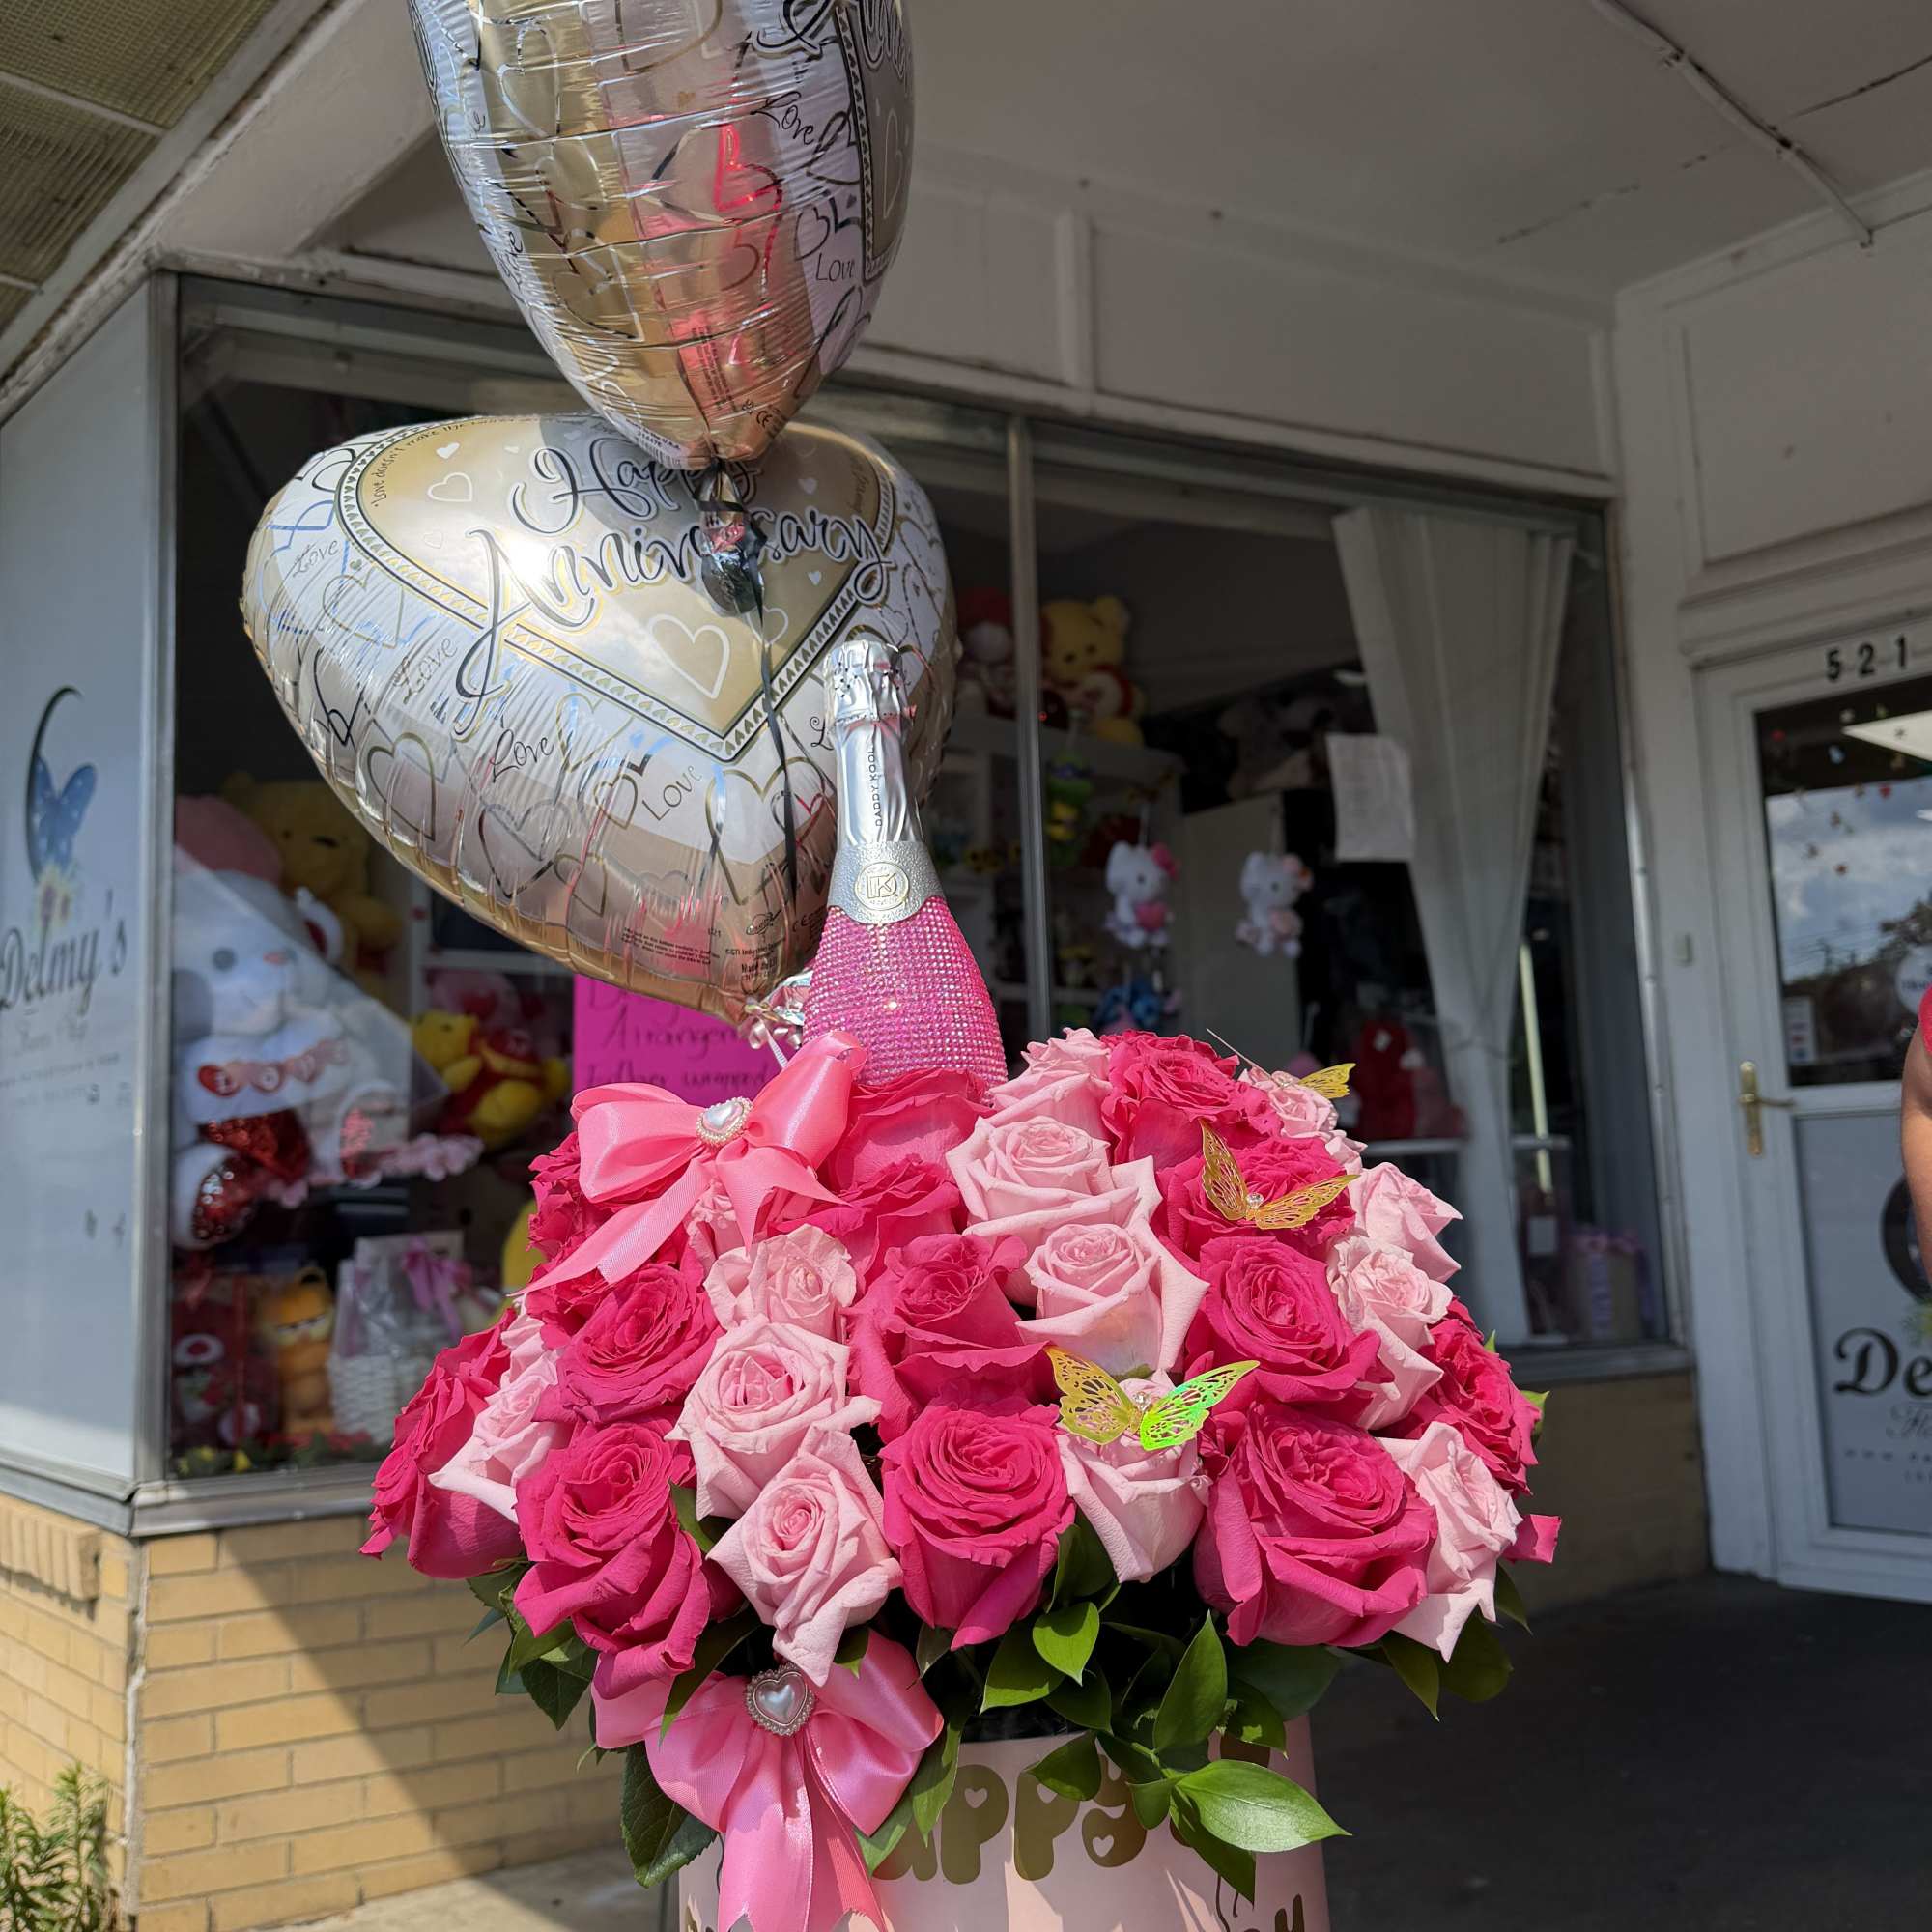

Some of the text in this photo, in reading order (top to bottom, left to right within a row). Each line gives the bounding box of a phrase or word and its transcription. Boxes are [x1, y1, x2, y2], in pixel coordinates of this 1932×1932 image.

[750, 91, 815, 145] Love
[292, 540, 338, 578] Love
[455, 509, 893, 737] Annivsary
[403, 637, 458, 705] Love
[1825, 635, 1907, 682] 521
[492, 728, 555, 783] Love
[871, 784, 884, 828] DADDY
